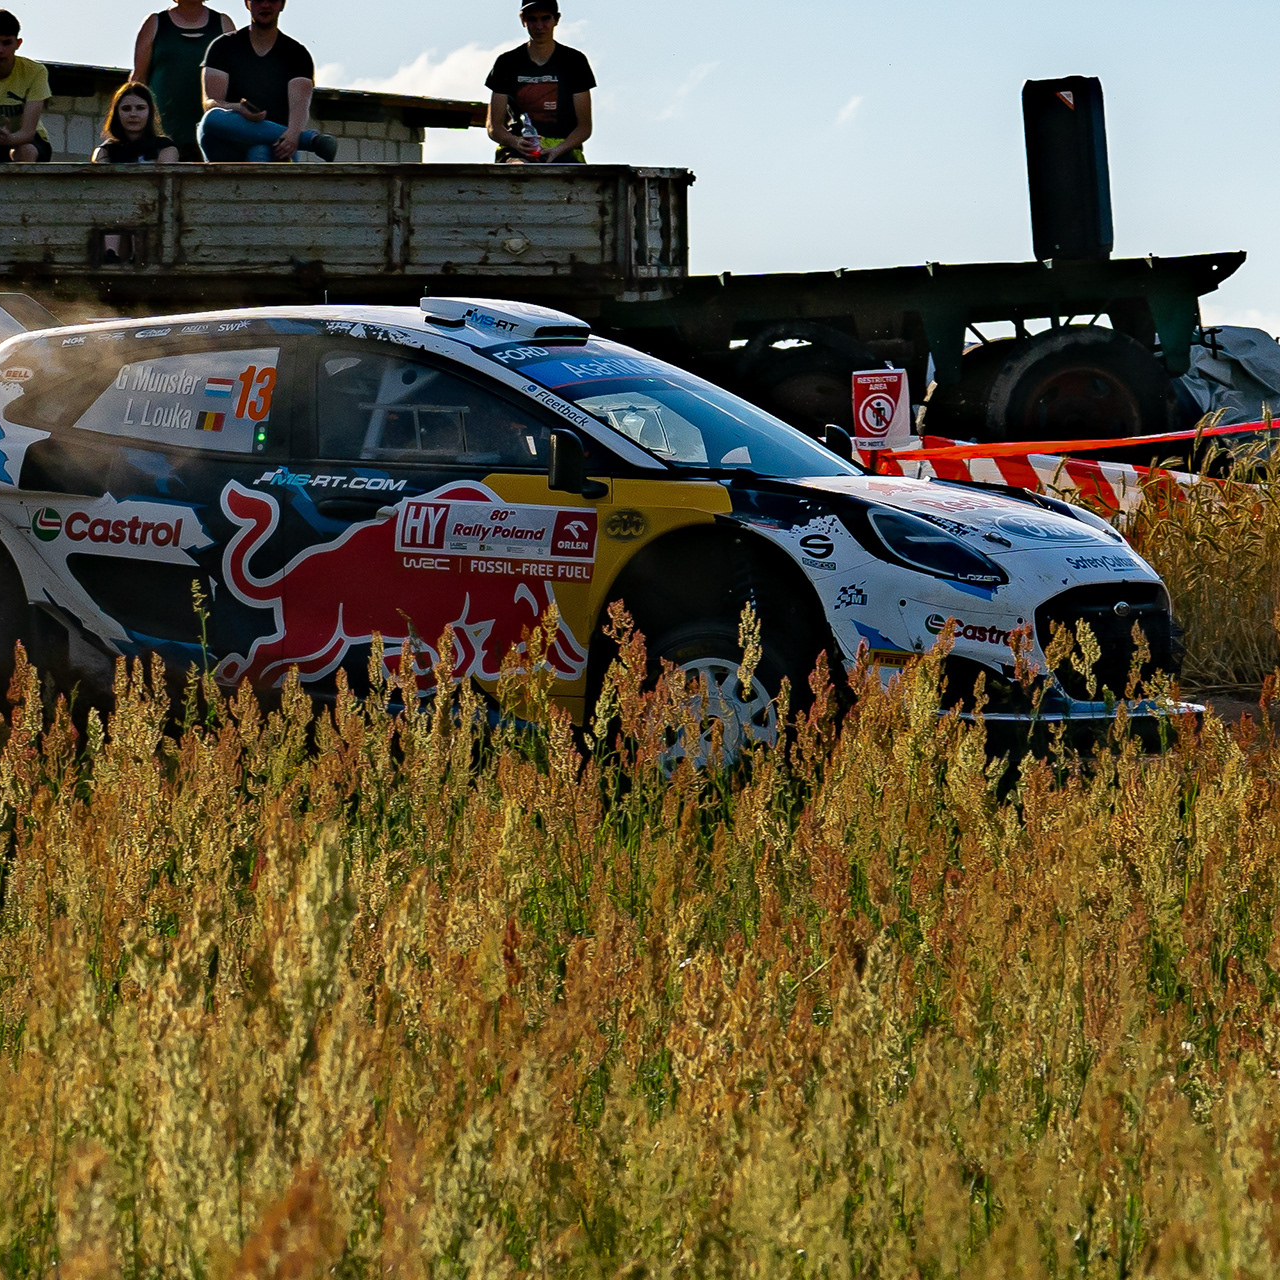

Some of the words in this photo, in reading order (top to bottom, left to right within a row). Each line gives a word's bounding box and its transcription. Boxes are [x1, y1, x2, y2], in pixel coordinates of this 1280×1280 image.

[492, 345, 550, 365] FORD
[5, 370, 30, 379] BELL
[115, 364, 130, 390] G
[132, 369, 203, 396] Munster
[857, 375, 898, 384] RESTRICTED
[235, 365, 277, 421] 13
[869, 383, 887, 391] AREA
[123, 398, 134, 425] L
[141, 399, 193, 430] Louka
[536, 390, 589, 428] Fleetback
[64, 511, 183, 548] Castrol
[404, 505, 446, 545] HY
[453, 523, 492, 542] Rally
[492, 524, 546, 541] Poland
[557, 540, 589, 550] ORLEN
[403, 556, 450, 570] WRC
[470, 559, 554, 578] FOSSIL-FREE
[557, 565, 590, 579] FUEL
[957, 573, 1002, 583] LAZER
